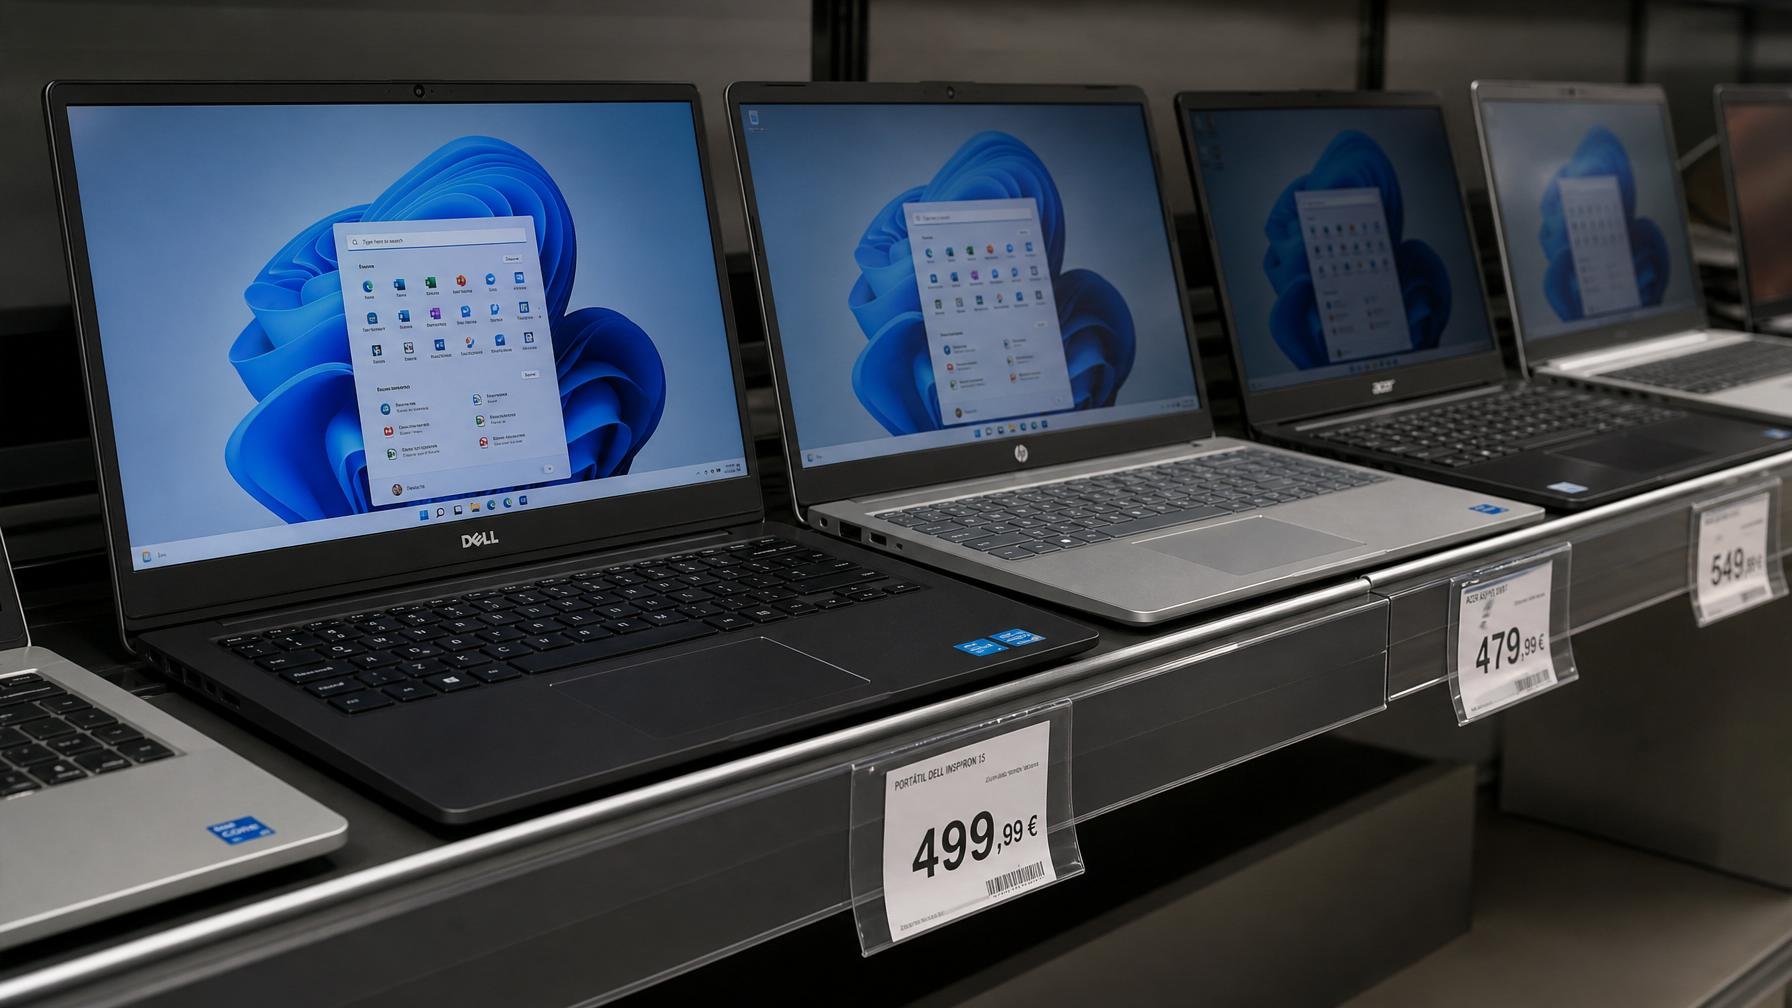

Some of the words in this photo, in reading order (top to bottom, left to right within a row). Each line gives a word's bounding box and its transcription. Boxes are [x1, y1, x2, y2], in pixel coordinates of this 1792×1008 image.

[460, 530, 499, 549] DELL
[1476, 627, 1537, 674] 479,99
[894, 773, 927, 791] PORTÁTIL
[928, 767, 944, 780] DELL
[978, 753, 986, 764] 15
[912, 811, 1023, 878] 499,99
[1027, 815, 1038, 837] €
